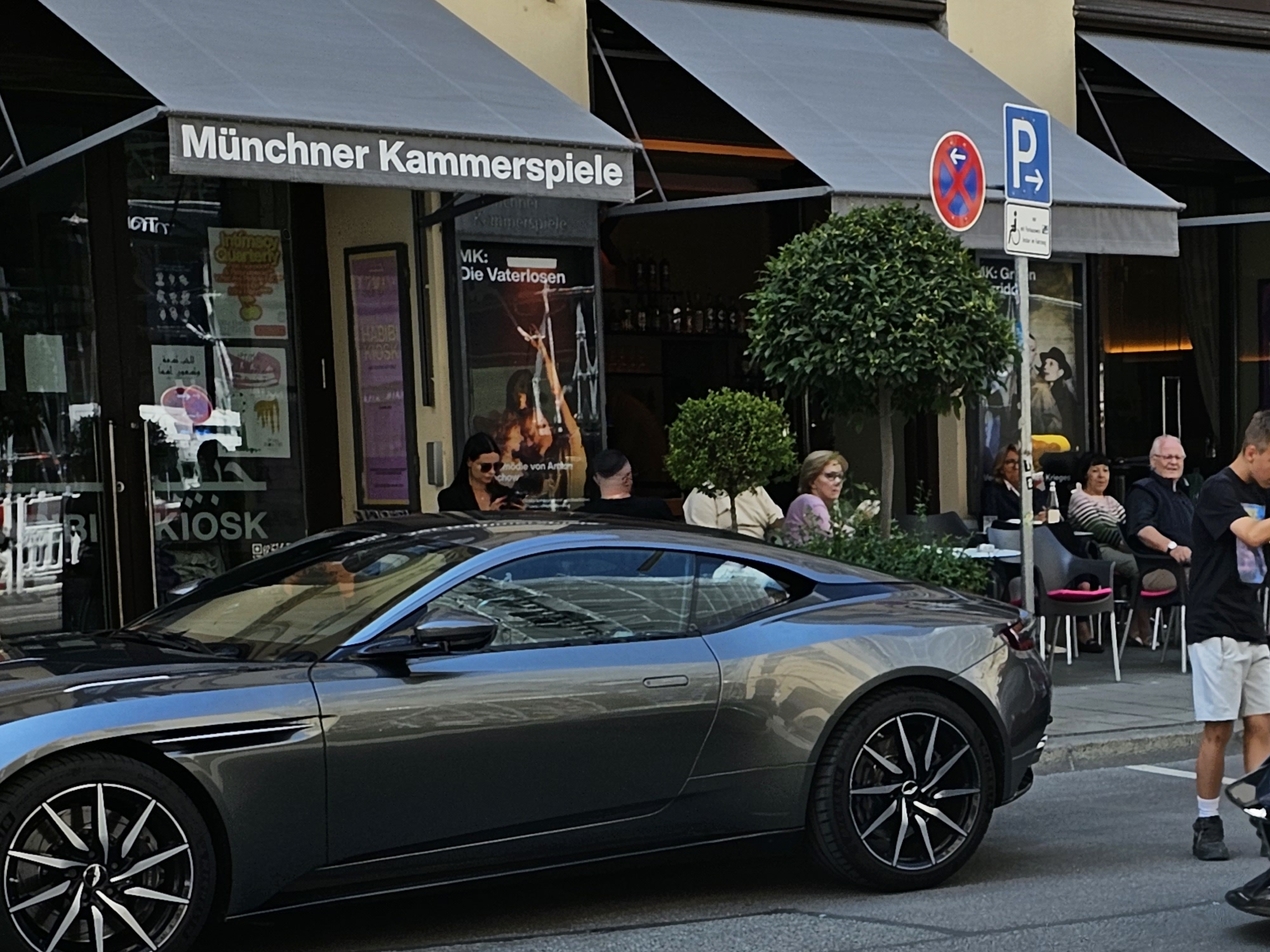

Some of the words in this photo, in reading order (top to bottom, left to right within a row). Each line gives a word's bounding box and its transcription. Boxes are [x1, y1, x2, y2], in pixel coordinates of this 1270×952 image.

[181, 124, 369, 169] Münchner
[378, 139, 623, 189] Kammerspiele
[1012, 118, 1037, 188] P
[460, 249, 488, 264] MK:
[461, 266, 484, 281] Die
[486, 266, 566, 284] Vaterlosen
[1000, 267, 1036, 280] Grn
[155, 511, 269, 541] KIOSK
